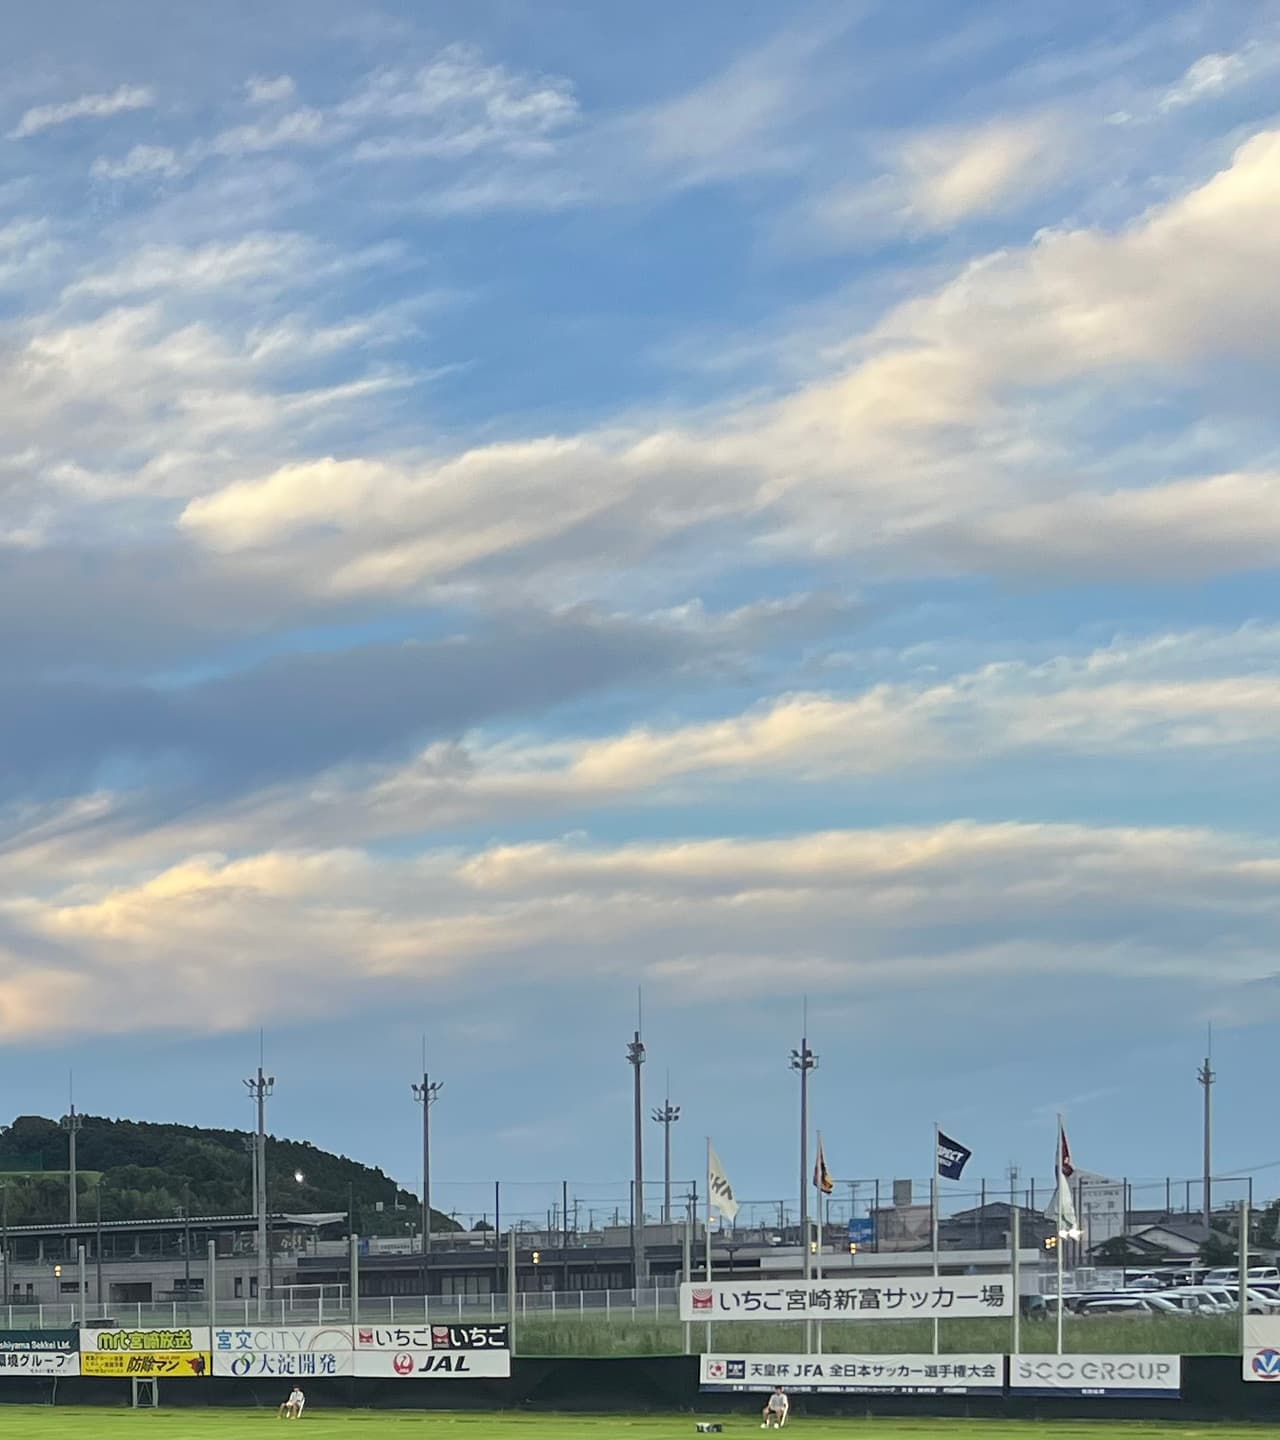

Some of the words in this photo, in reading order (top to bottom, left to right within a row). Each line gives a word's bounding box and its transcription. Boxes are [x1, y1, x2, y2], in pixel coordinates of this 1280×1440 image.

[720, 1284, 1005, 1312] いちご宮崎新富サッカー場
[376, 1328, 429, 1347] いちご
[451, 1326, 506, 1347] いちご
[126, 1355, 180, 1373] 防除マン
[257, 1353, 337, 1375] 大淀開発
[418, 1355, 471, 1373] JAL
[750, 1363, 790, 1378] 天皇杯
[793, 1364, 824, 1377] JFA
[829, 1362, 997, 1378] 全日本サッカー選手権大会
[1080, 1362, 1171, 1381] GROUP
